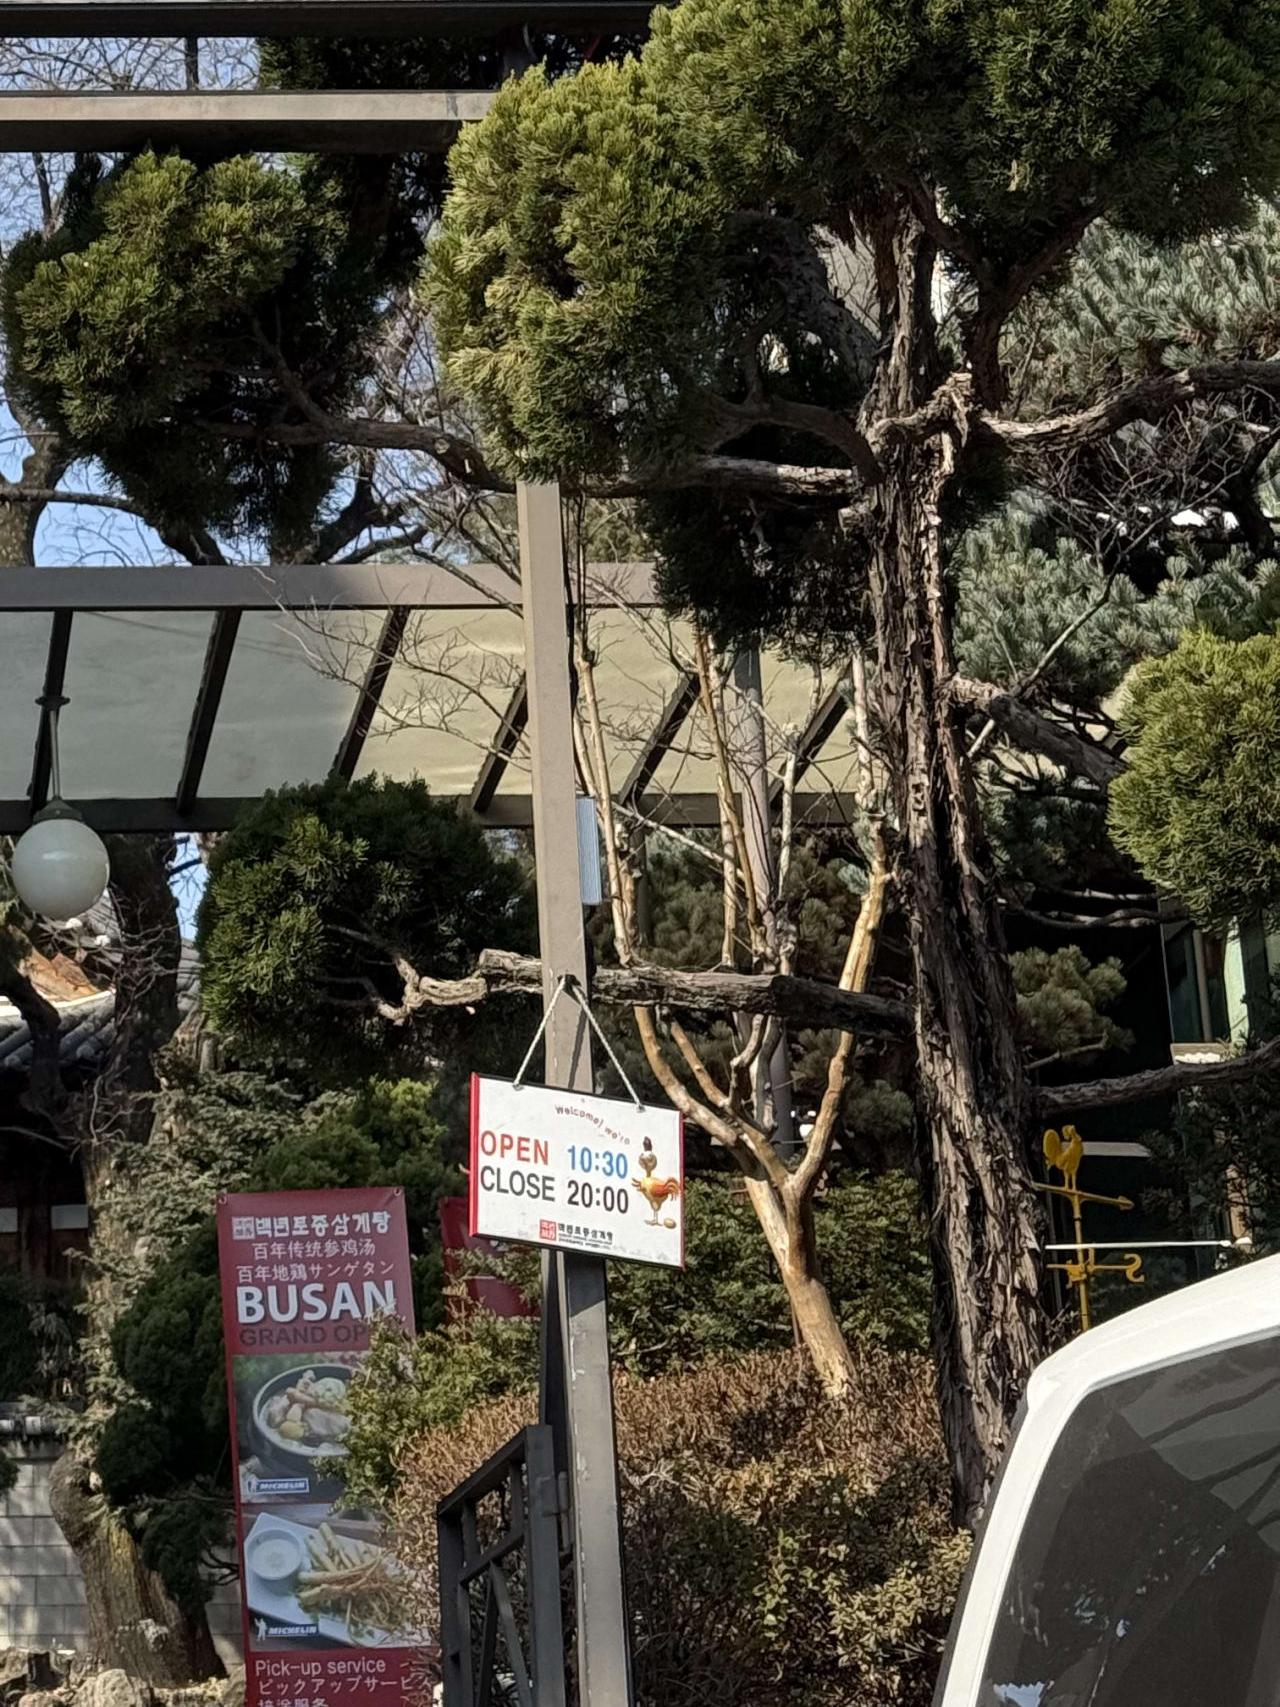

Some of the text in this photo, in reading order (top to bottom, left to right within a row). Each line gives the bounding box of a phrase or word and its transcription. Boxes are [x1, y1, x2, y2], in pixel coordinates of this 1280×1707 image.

[480, 1130, 628, 1179] OPEN 10:30
[480, 1165, 629, 1214] CLOSE 20:00
[255, 1210, 392, 1239] 백년토종삼계탕
[251, 1238, 376, 1261] 百年传统参鸡汤
[236, 1279, 396, 1325] BUSAN
[239, 1324, 368, 1347] GRAND OP
[268, 1625, 317, 1635] MICHELIN
[255, 1656, 387, 1677] Pick-up service
